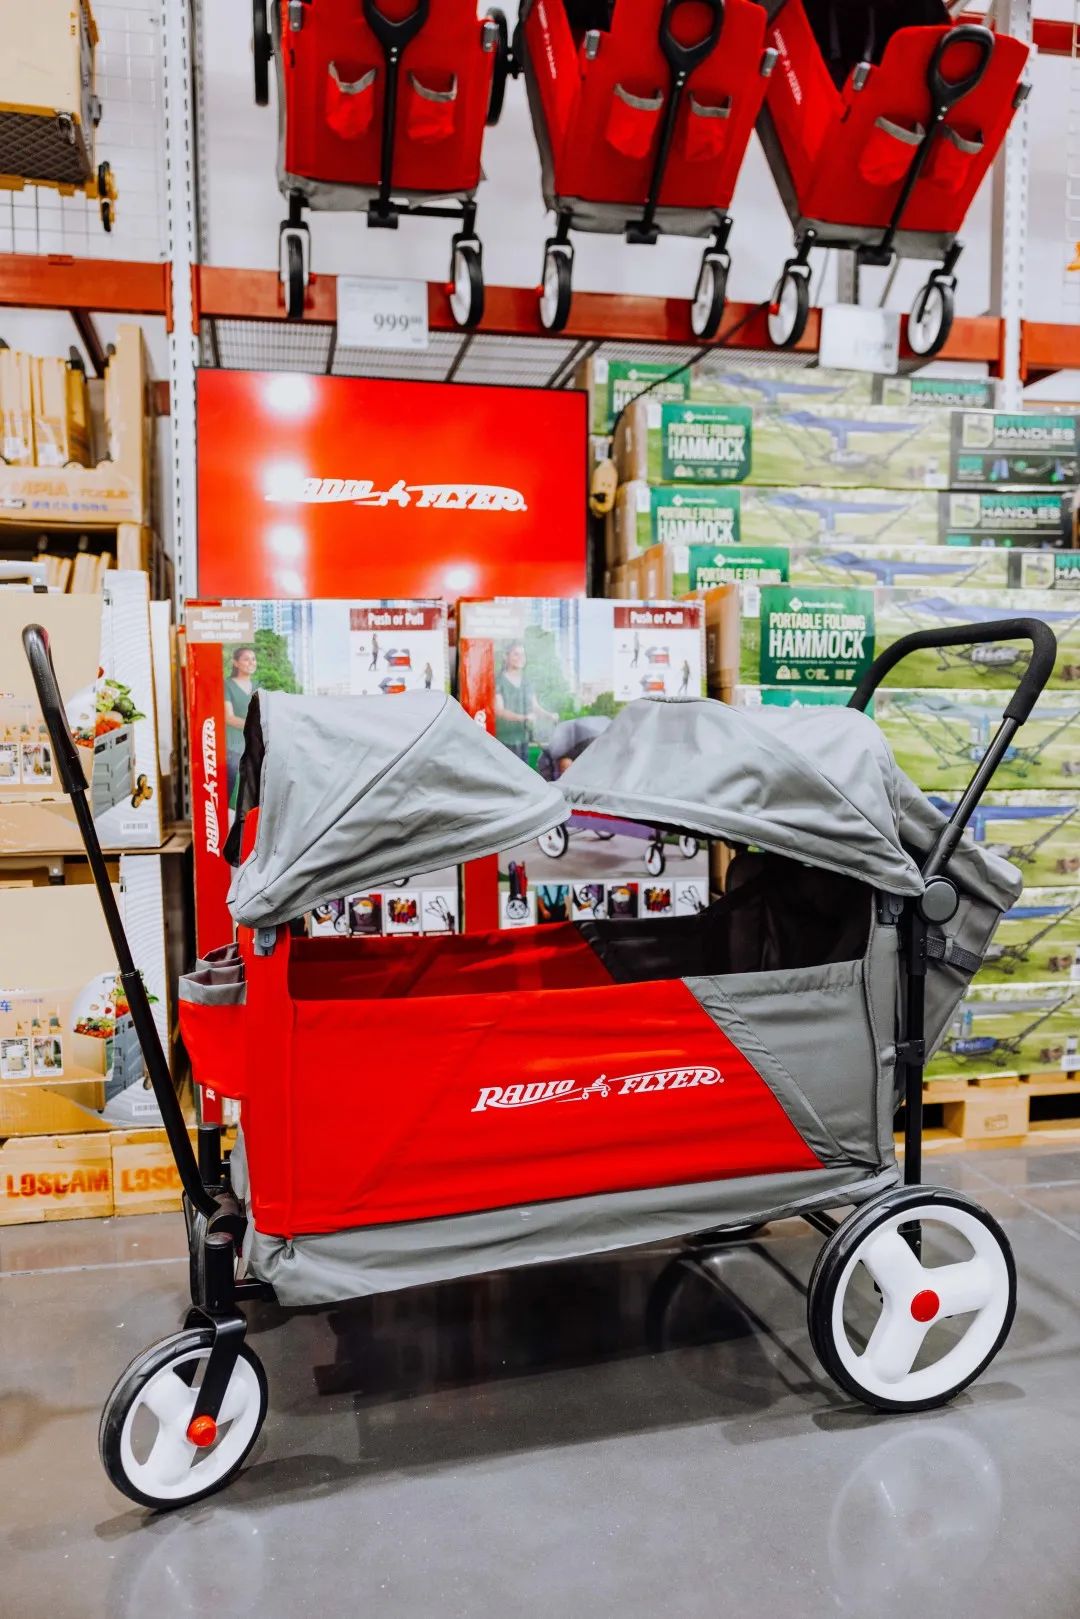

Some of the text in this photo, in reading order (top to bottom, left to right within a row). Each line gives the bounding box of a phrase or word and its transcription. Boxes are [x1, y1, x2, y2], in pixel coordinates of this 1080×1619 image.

[994, 427, 1075, 440] HANDLES
[668, 436, 746, 461] HAMMOCK
[265, 477, 527, 511] ADIO FLYER
[981, 506, 1061, 519] HANDLES
[657, 518, 735, 544] HAMMOCK
[368, 612, 424, 625] Push or Pull
[630, 611, 652, 624] Push
[665, 611, 683, 624] Pull
[769, 612, 866, 631] PORTABLE FOLDING
[768, 629, 866, 659] HAMMOCK
[202, 716, 220, 857] RADIO FLYER
[470, 1065, 724, 1112] RADIO FLYER
[6, 1165, 184, 1198] LOSCAM LOSC
